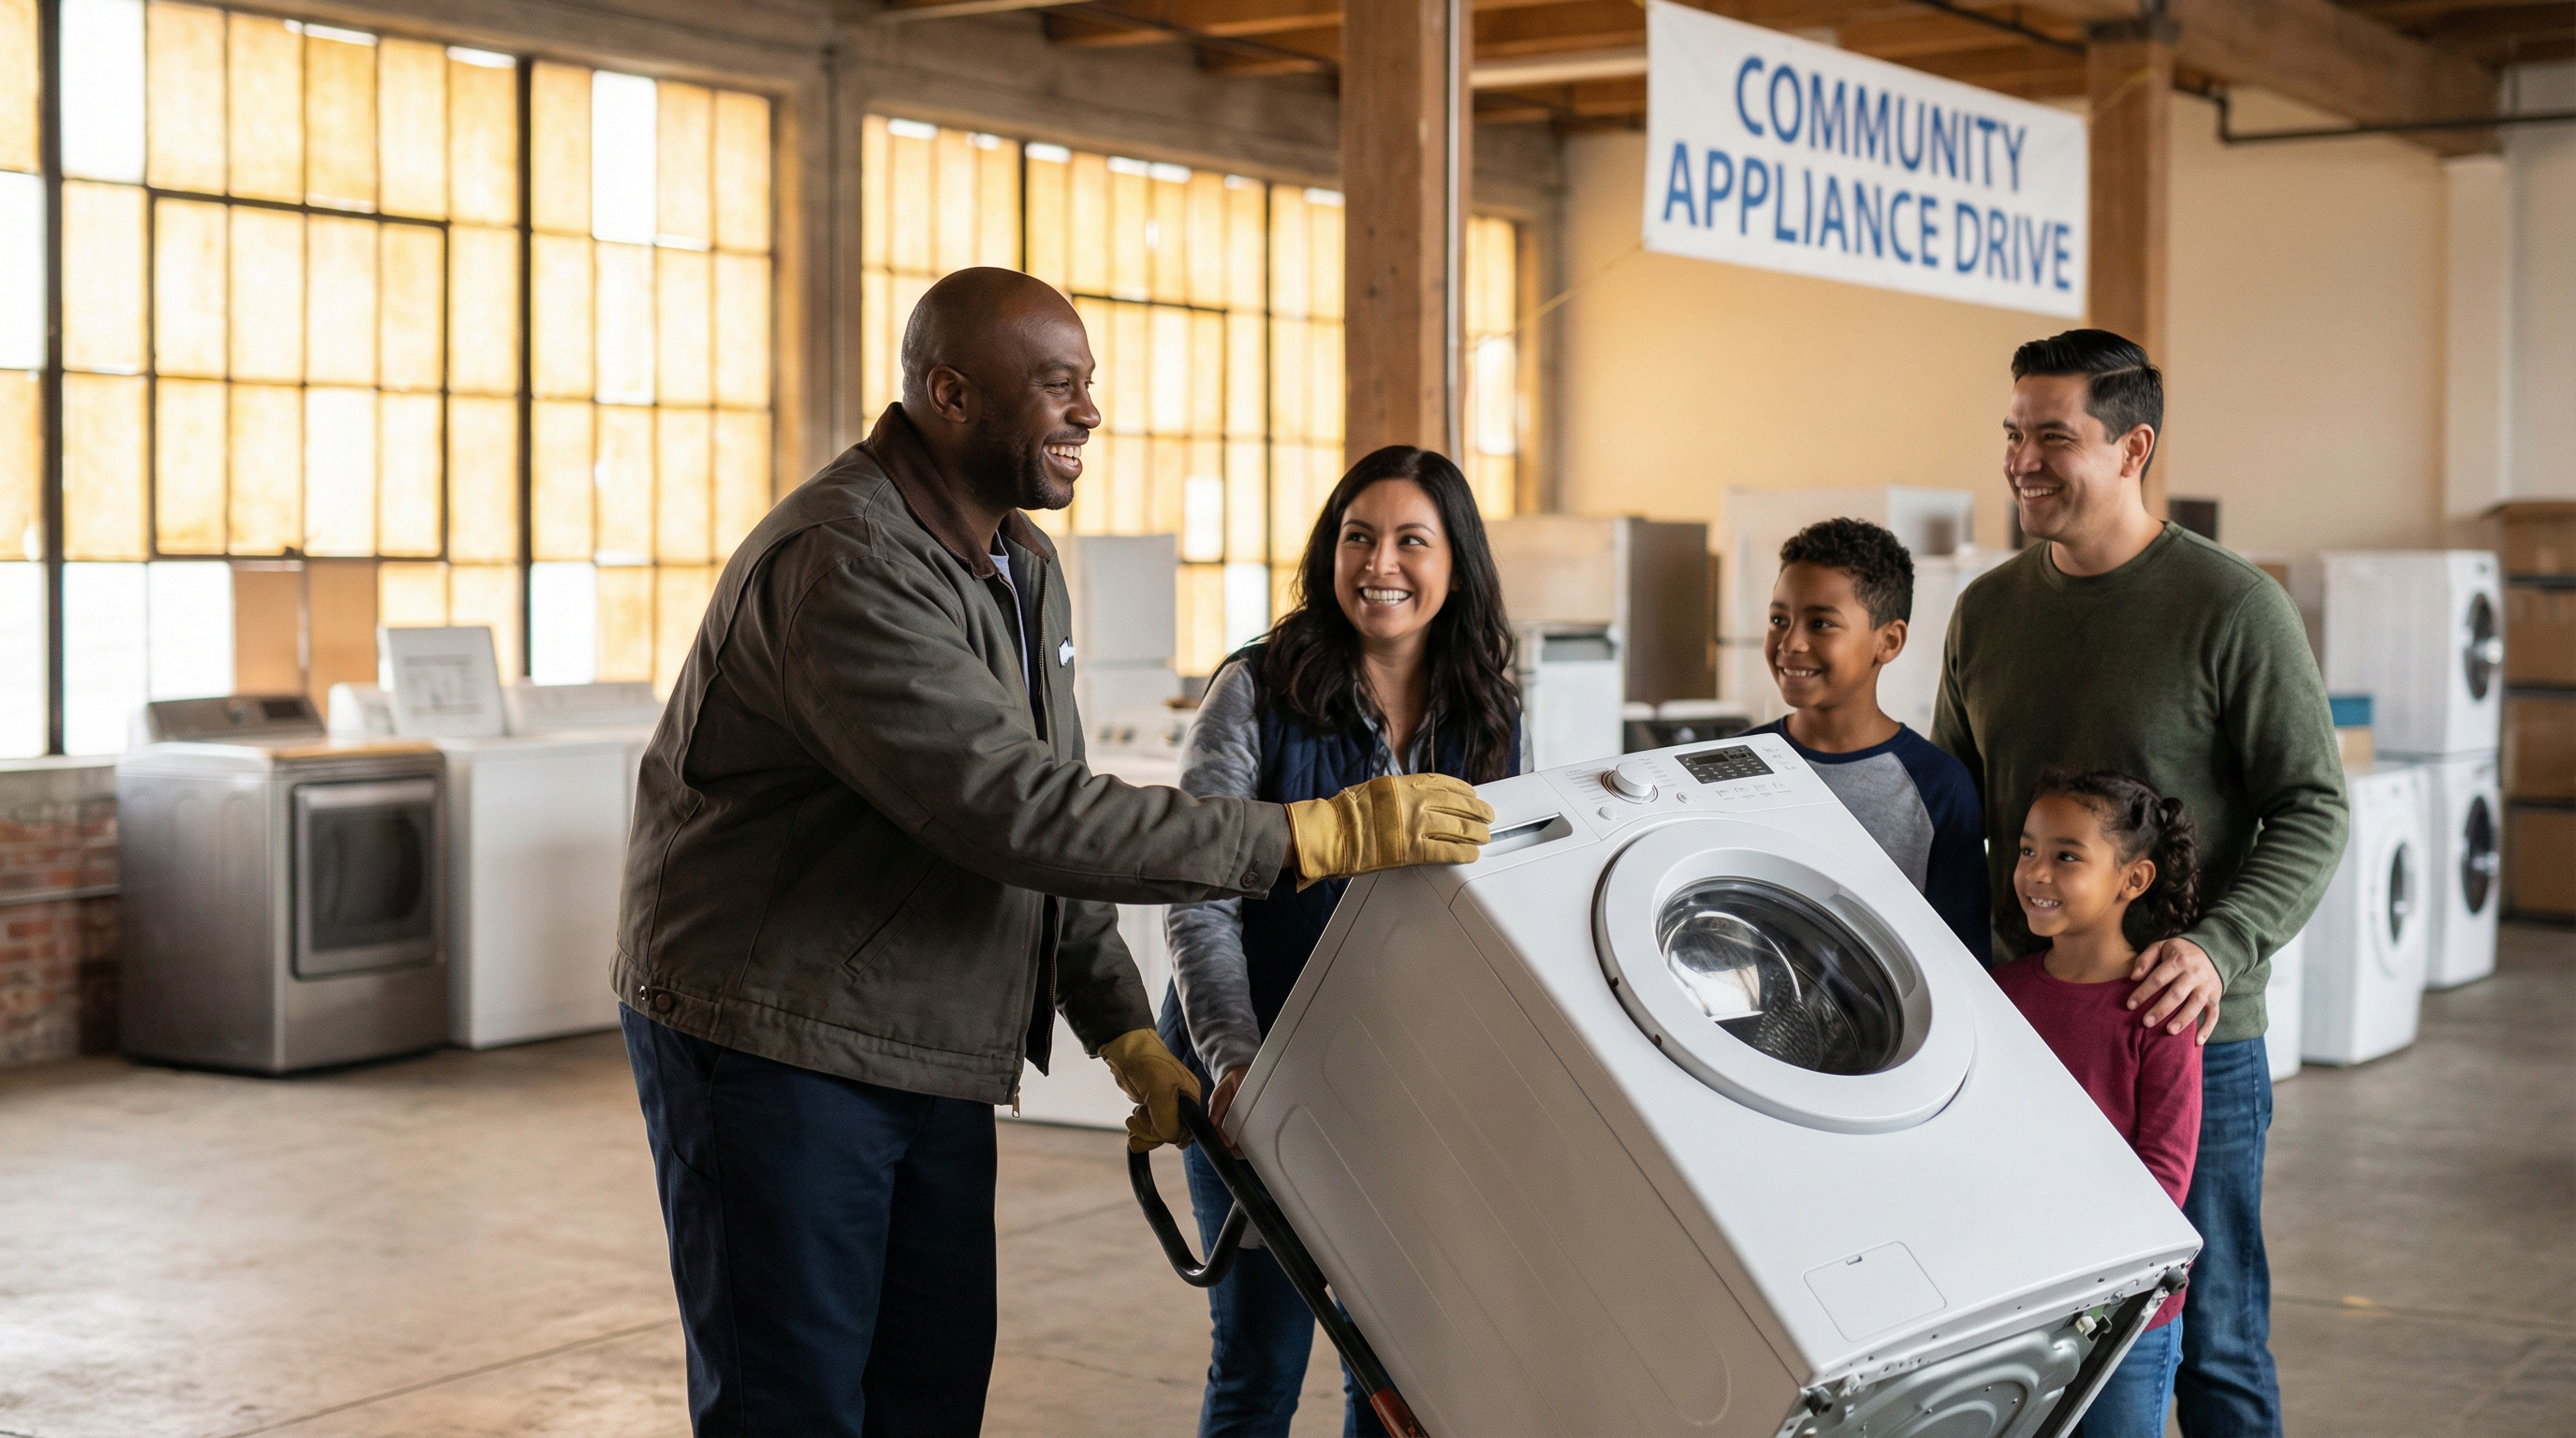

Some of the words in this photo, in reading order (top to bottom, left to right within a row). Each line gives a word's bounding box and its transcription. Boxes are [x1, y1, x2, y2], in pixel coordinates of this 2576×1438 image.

[1735, 55, 2026, 192] COMMUNITY
[1662, 140, 1939, 268] APPLIANCE
[1955, 200, 2071, 291] DRIVE
